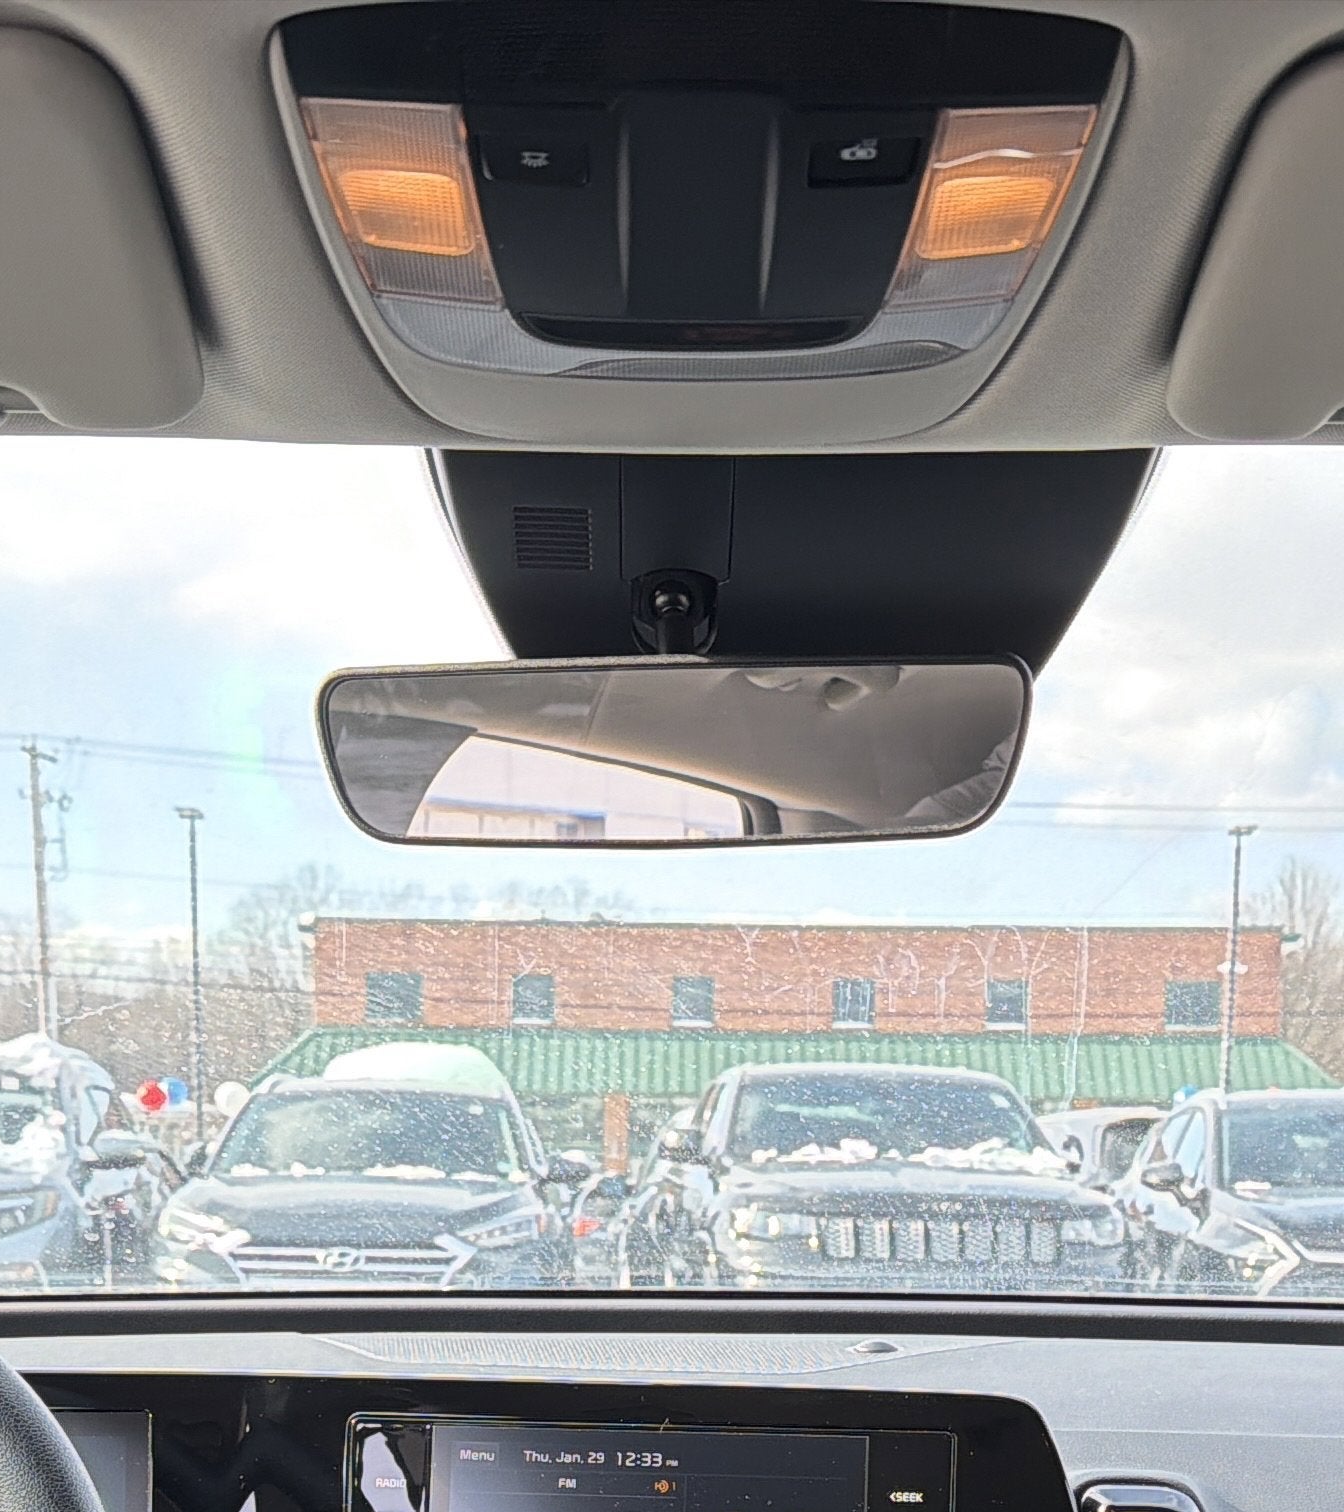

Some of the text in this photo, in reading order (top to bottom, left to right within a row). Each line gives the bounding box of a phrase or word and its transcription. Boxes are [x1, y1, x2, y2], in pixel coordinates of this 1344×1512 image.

[459, 1449, 496, 1462] Menu
[587, 1452, 606, 1464] 29
[616, 1451, 663, 1467] 12:33
[375, 1478, 407, 1488] RADIO
[558, 1478, 577, 1489] FM
